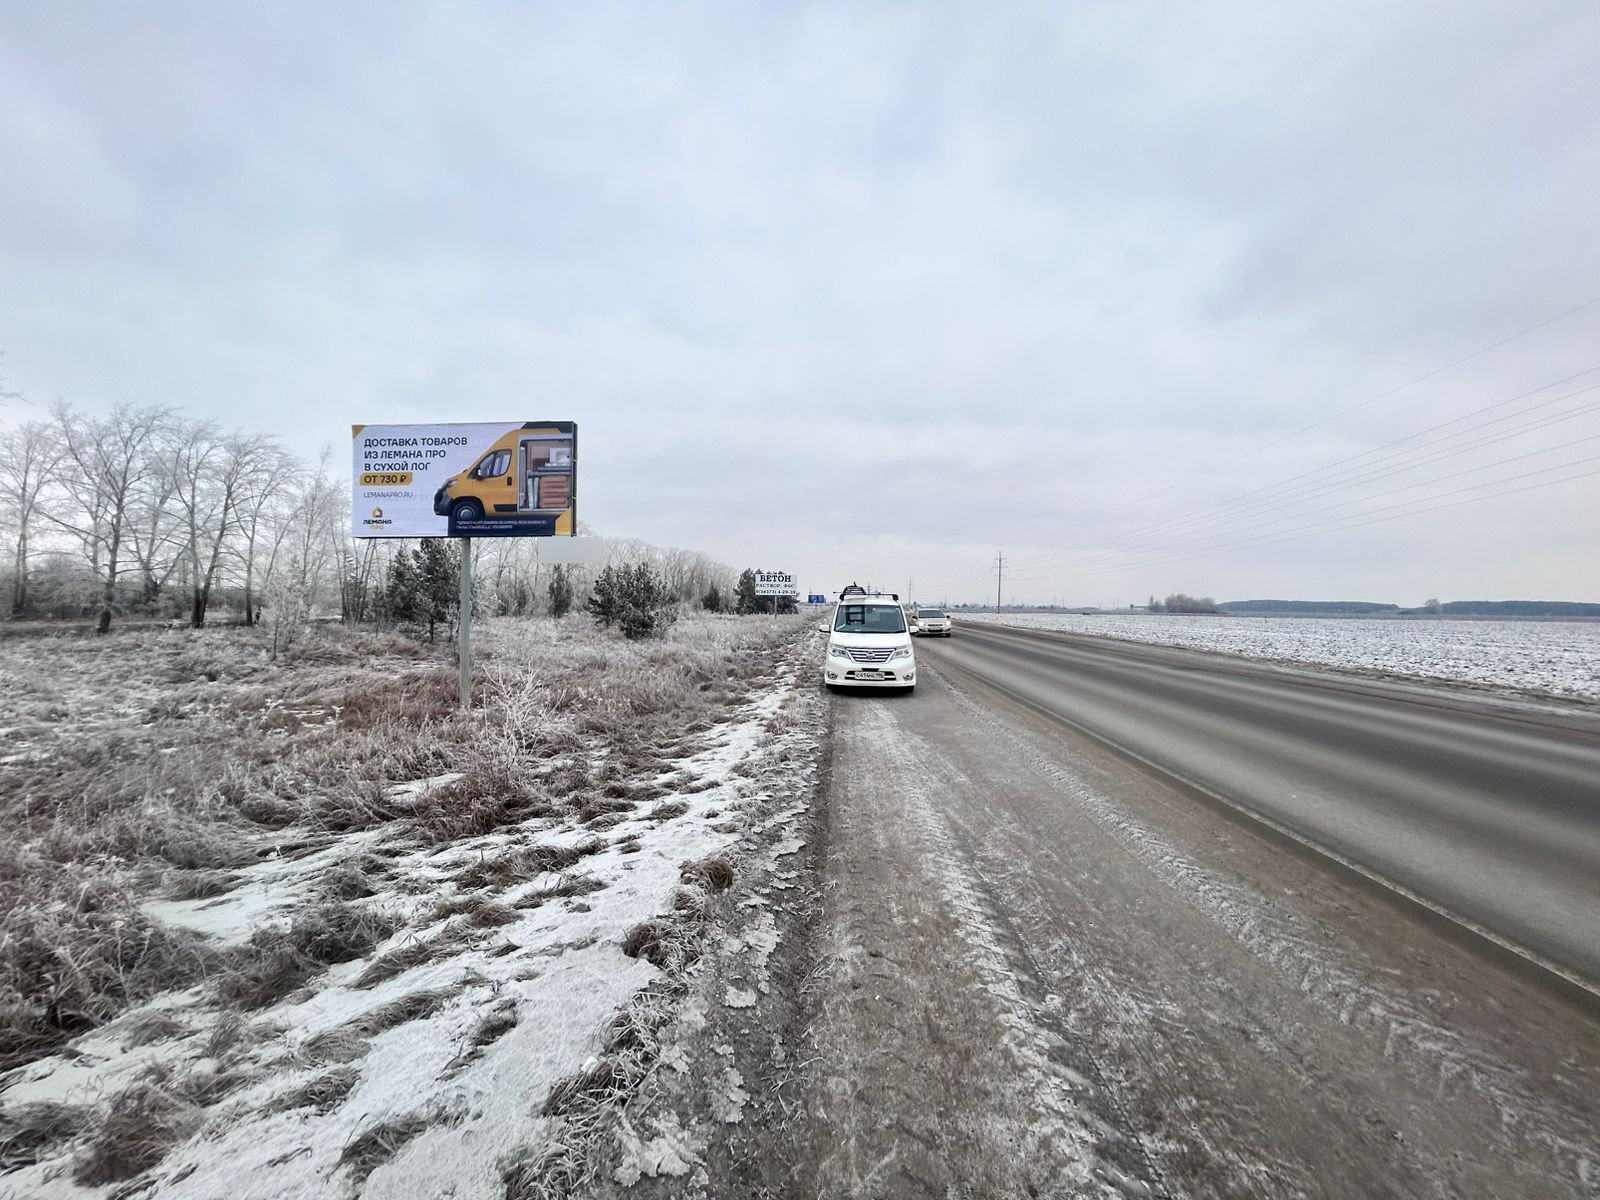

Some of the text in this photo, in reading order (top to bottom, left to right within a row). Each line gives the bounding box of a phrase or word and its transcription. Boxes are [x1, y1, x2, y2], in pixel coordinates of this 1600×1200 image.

[364, 437, 468, 448] ДОСТАВКА ТОВАРОВ
[364, 450, 446, 459] ИЗ ЛЕМАНА ПРО
[364, 461, 431, 471] В СУХОЙ ЛОГ
[364, 475, 378, 484] ОТ
[380, 475, 397, 483] 730
